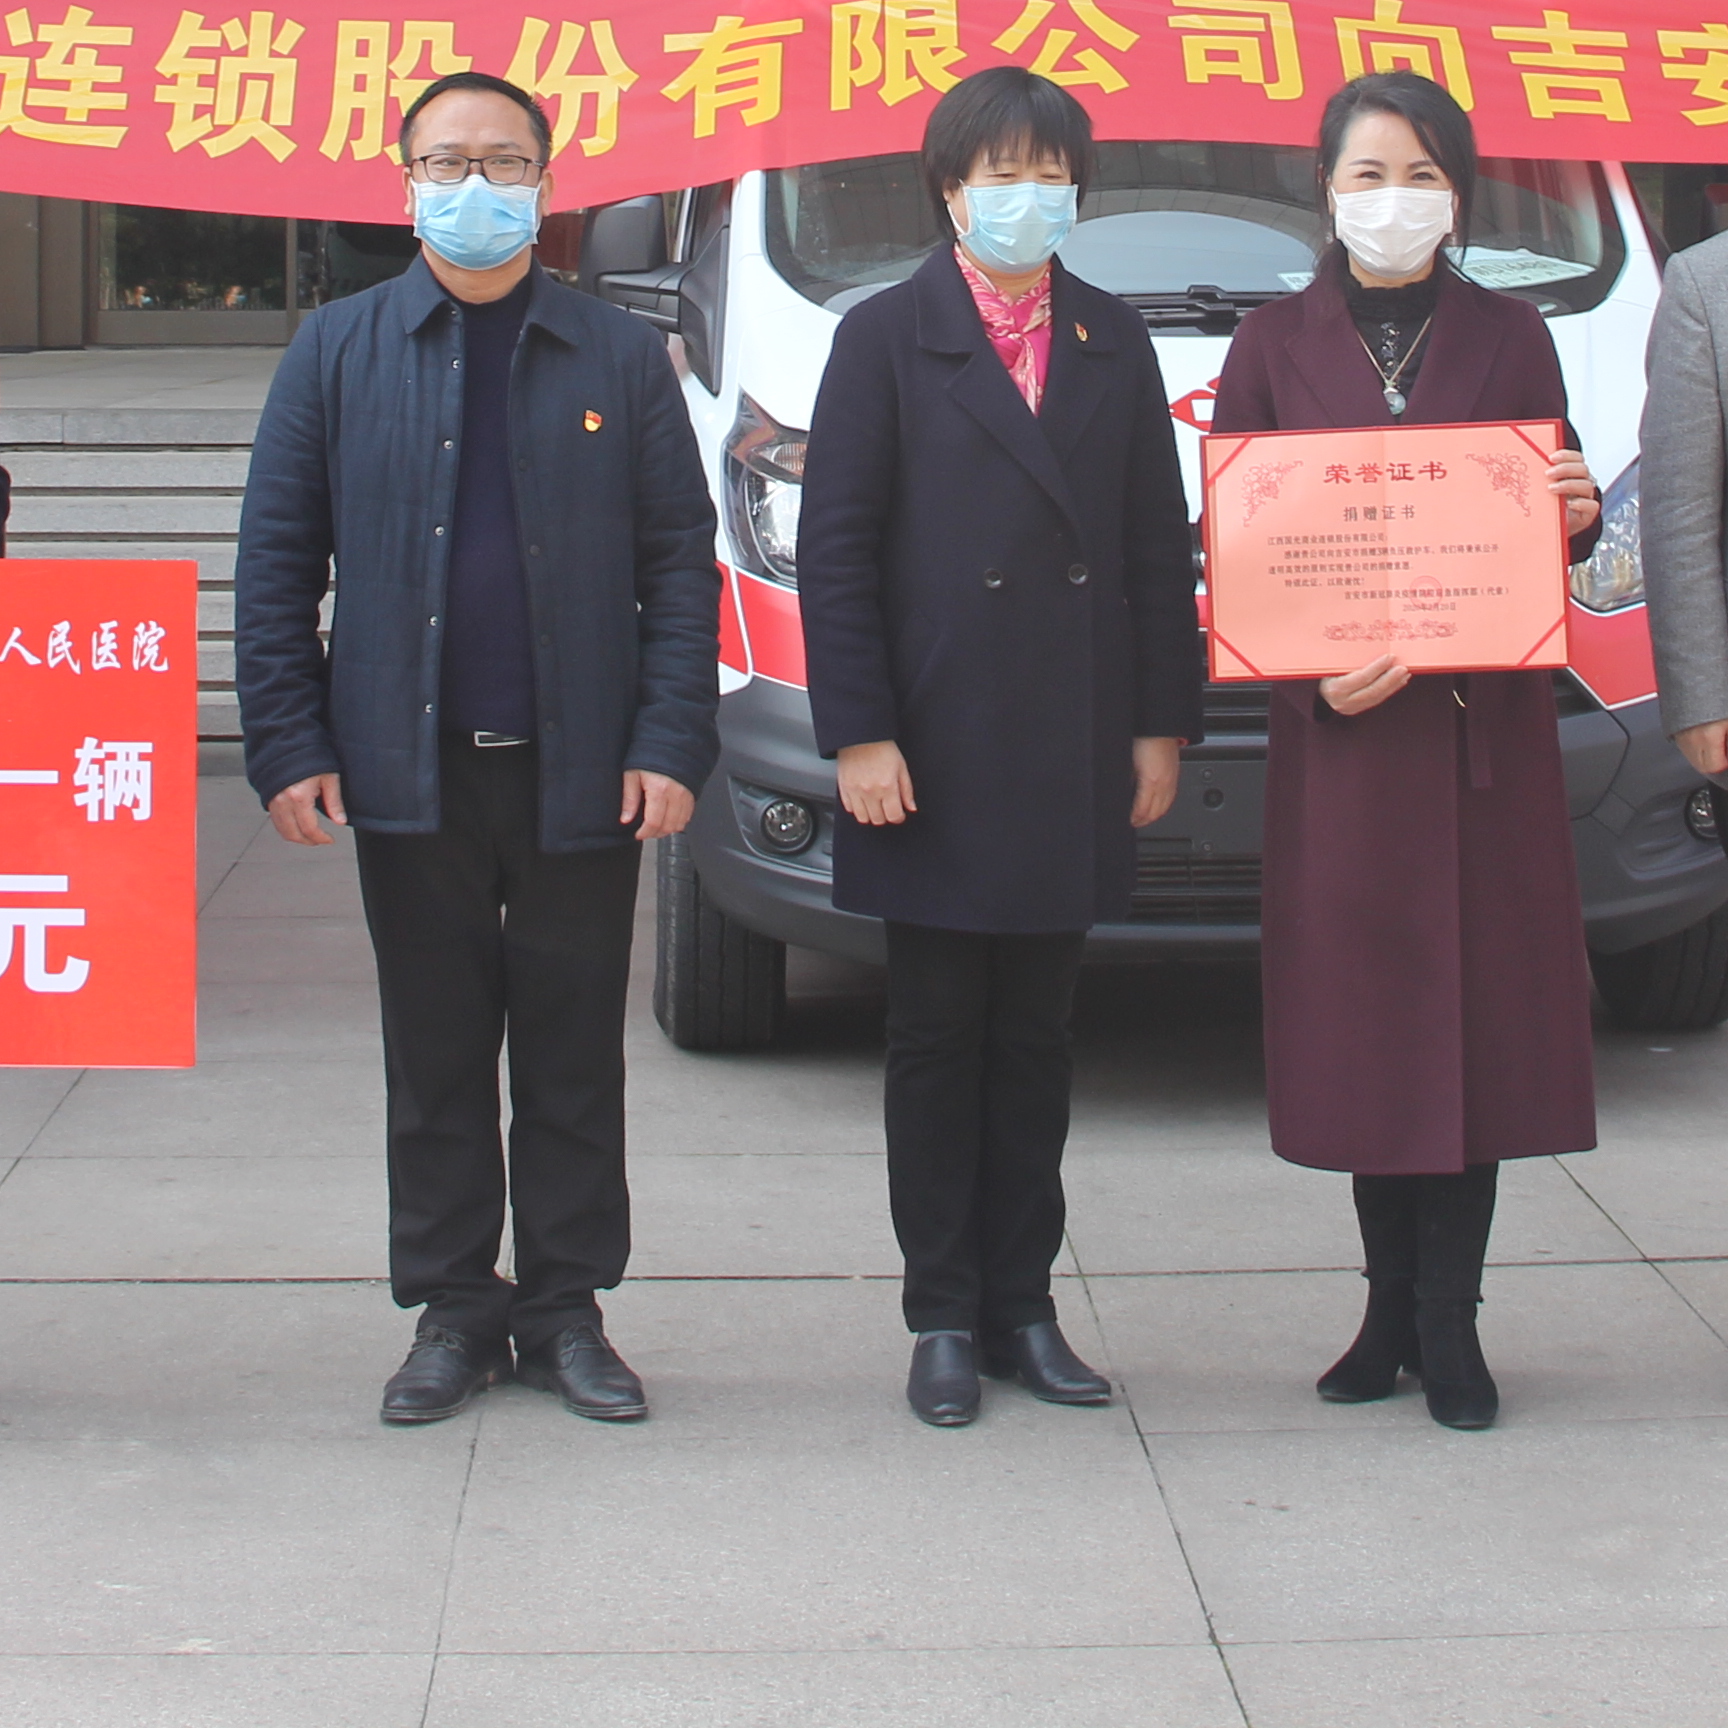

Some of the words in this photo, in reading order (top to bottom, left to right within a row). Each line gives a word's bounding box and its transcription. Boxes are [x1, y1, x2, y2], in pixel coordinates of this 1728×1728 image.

[1323, 460, 1447, 484] 荣誉证书
[1343, 504, 1415, 522] 捐赠证书
